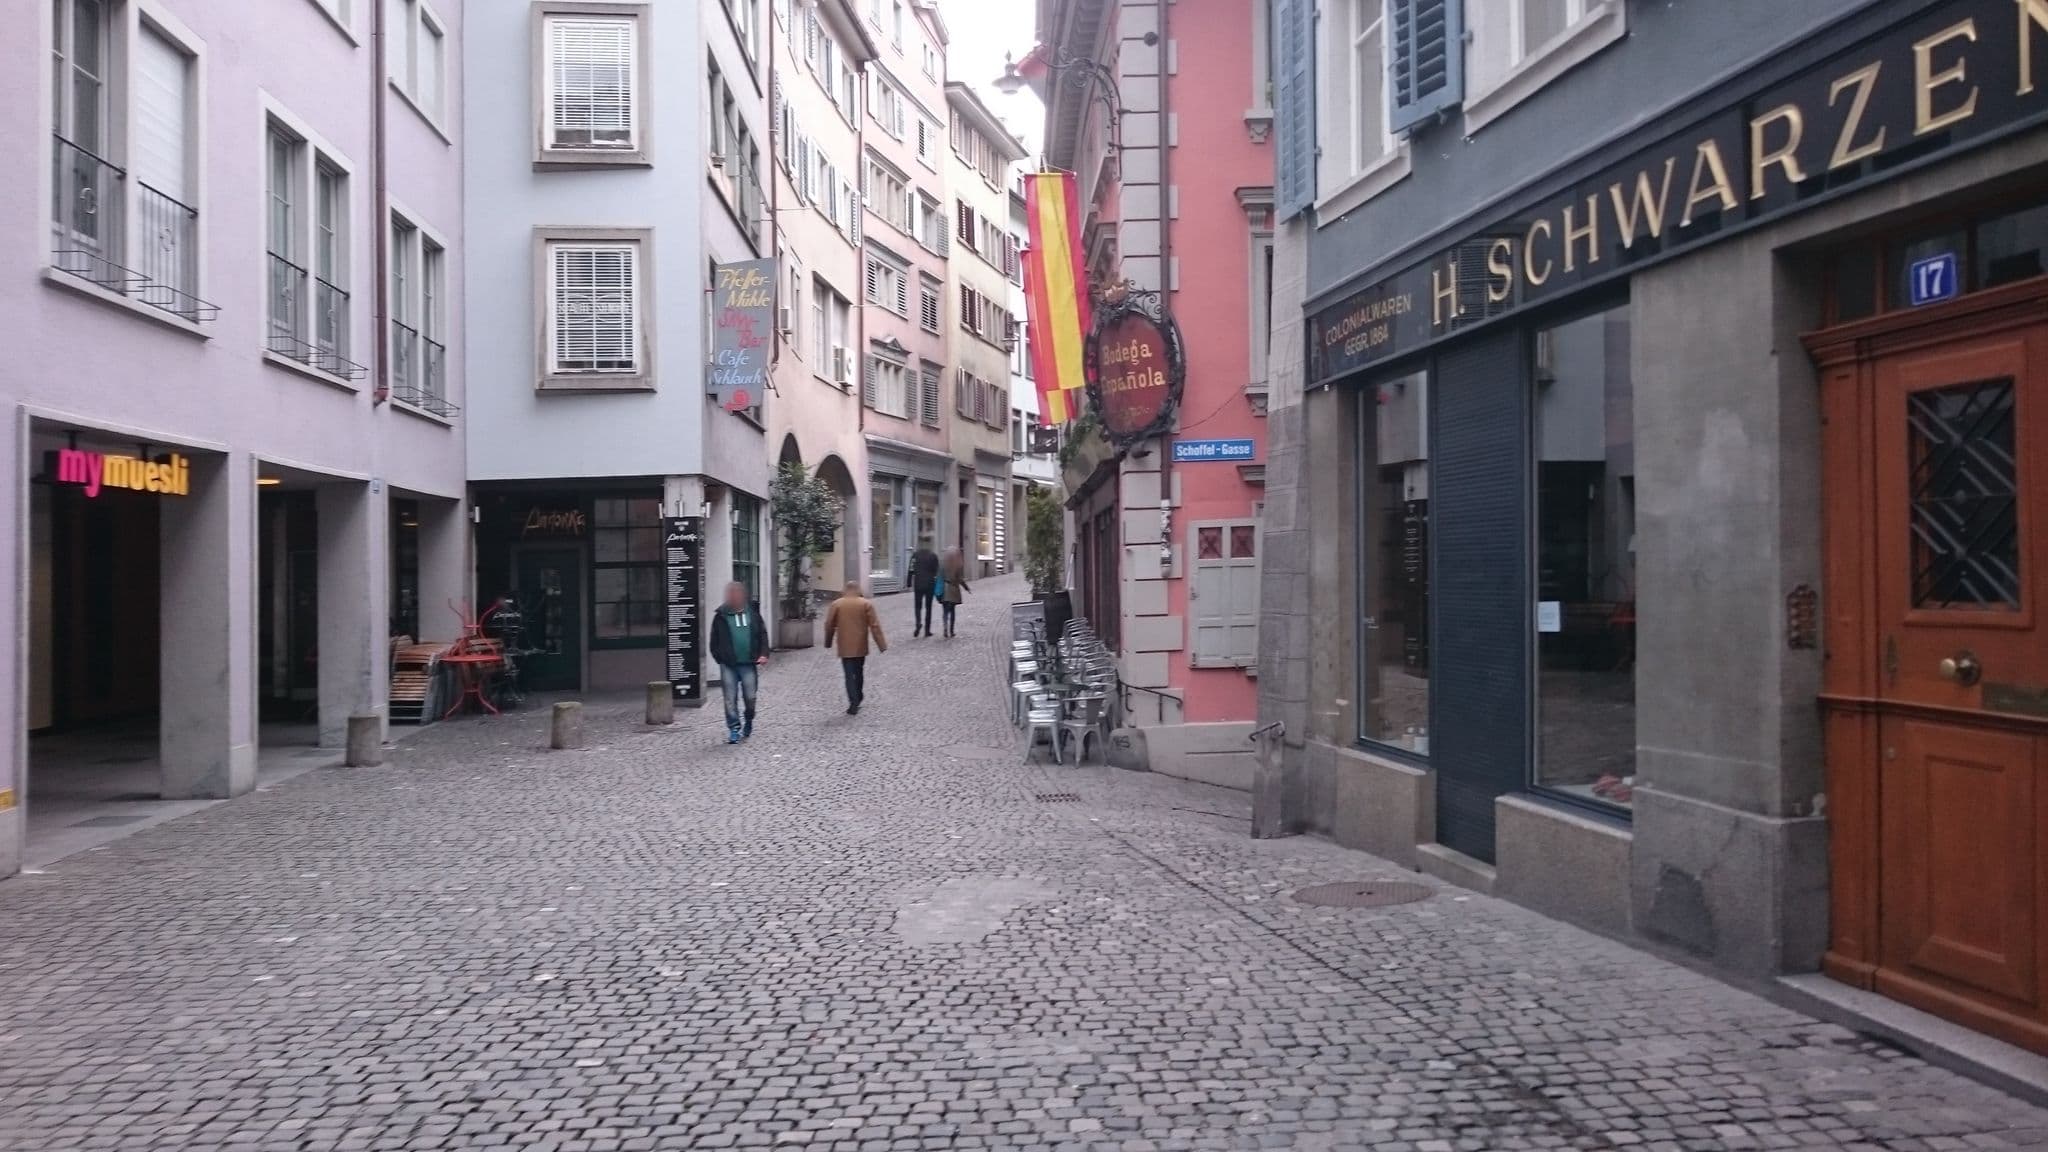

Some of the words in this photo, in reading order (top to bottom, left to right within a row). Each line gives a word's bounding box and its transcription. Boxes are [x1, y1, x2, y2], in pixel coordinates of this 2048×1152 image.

[1920, 260, 1945, 299] 17
[1325, 293, 1413, 346] COLONIALWAREN
[1103, 338, 1153, 365] Bodega
[58, 447, 190, 498] mymuesli
